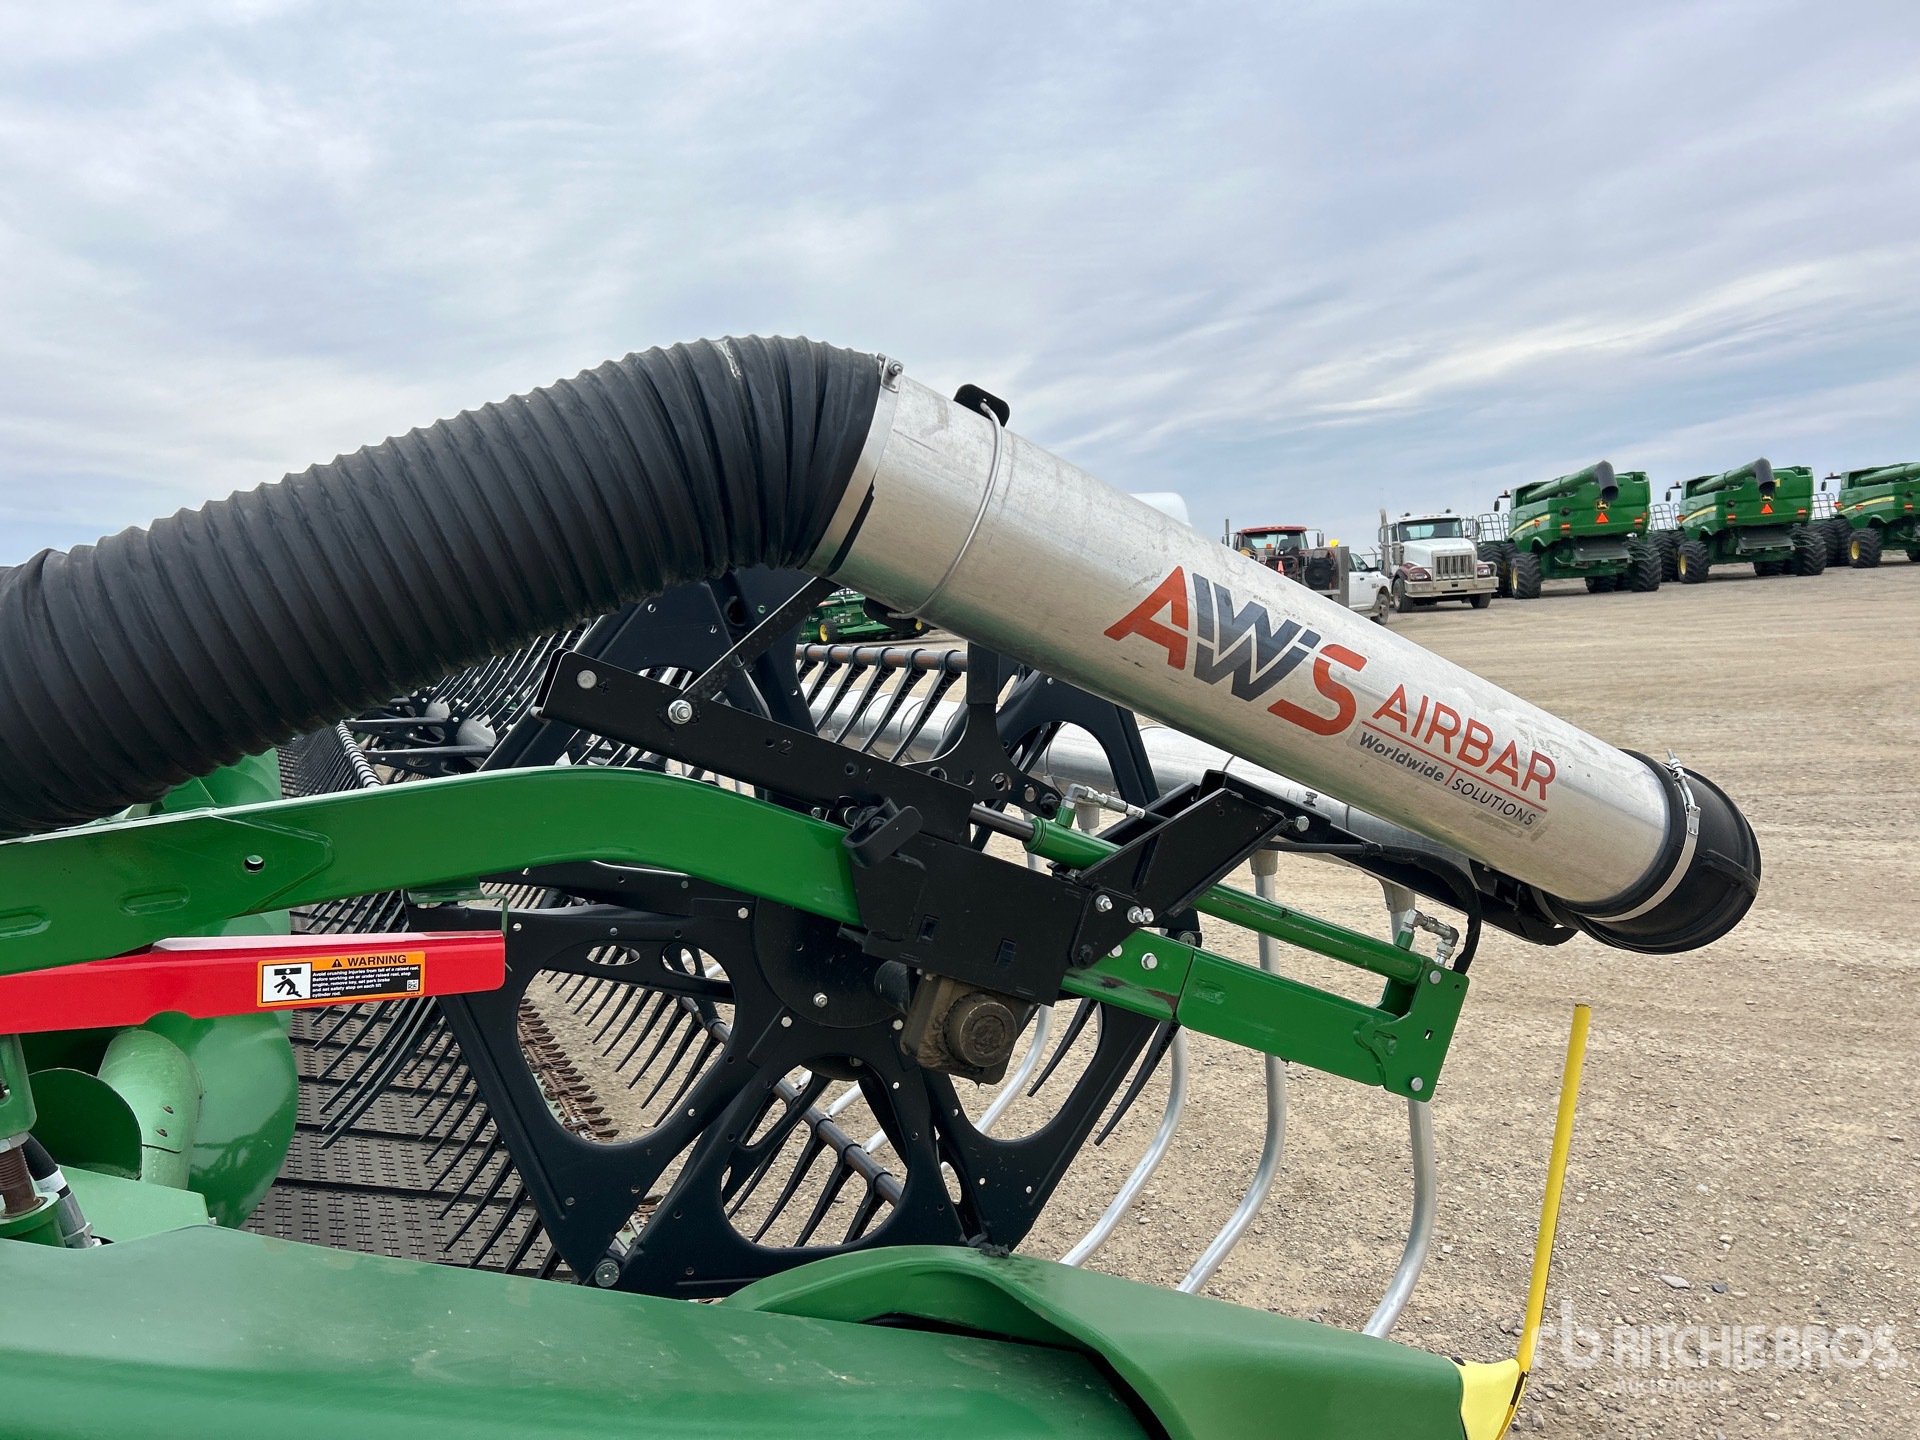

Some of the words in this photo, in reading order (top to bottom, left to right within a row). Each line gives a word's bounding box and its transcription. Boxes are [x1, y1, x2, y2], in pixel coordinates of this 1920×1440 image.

[1359, 731, 1445, 782] Worldwide
[1452, 778, 1536, 826] SOLUTIONS
[1372, 683, 1556, 800] AIRBAR
[347, 955, 406, 966] WARNING
